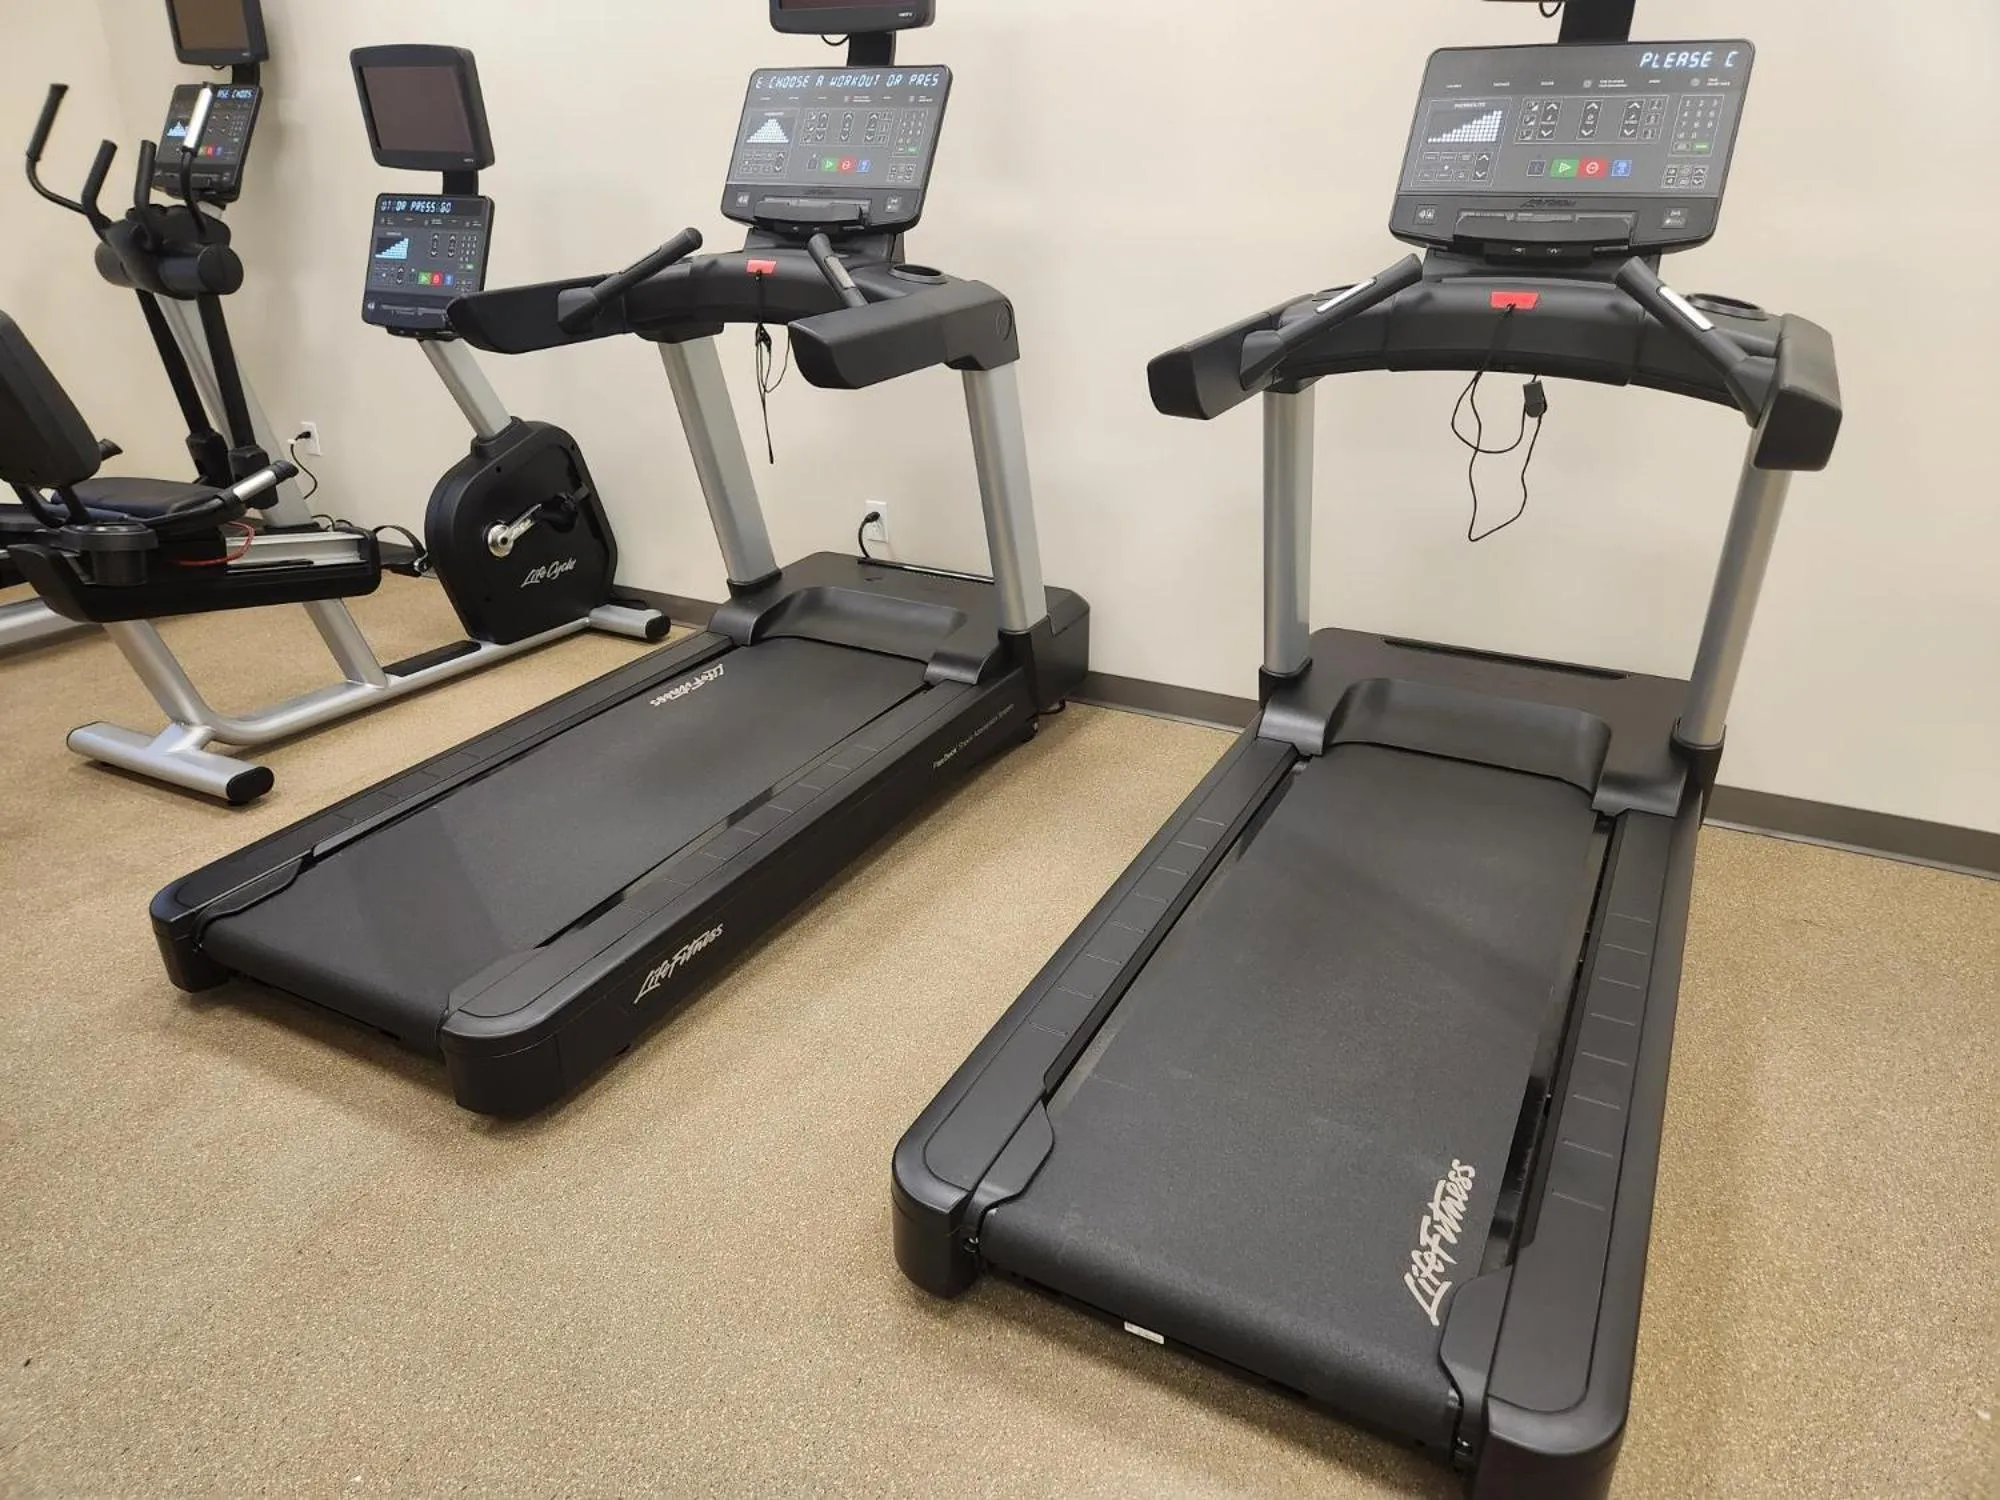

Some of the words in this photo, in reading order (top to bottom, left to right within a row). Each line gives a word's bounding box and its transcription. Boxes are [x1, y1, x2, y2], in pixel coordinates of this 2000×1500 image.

[1640, 51, 1714, 69] PLEASE
[1724, 51, 1739, 68] C
[755, 77, 763, 89] E
[769, 75, 809, 88] CHOOSE
[815, 75, 823, 86] A
[830, 74, 880, 88] WORKOUT
[886, 74, 903, 87] OR
[909, 73, 940, 87] PRES
